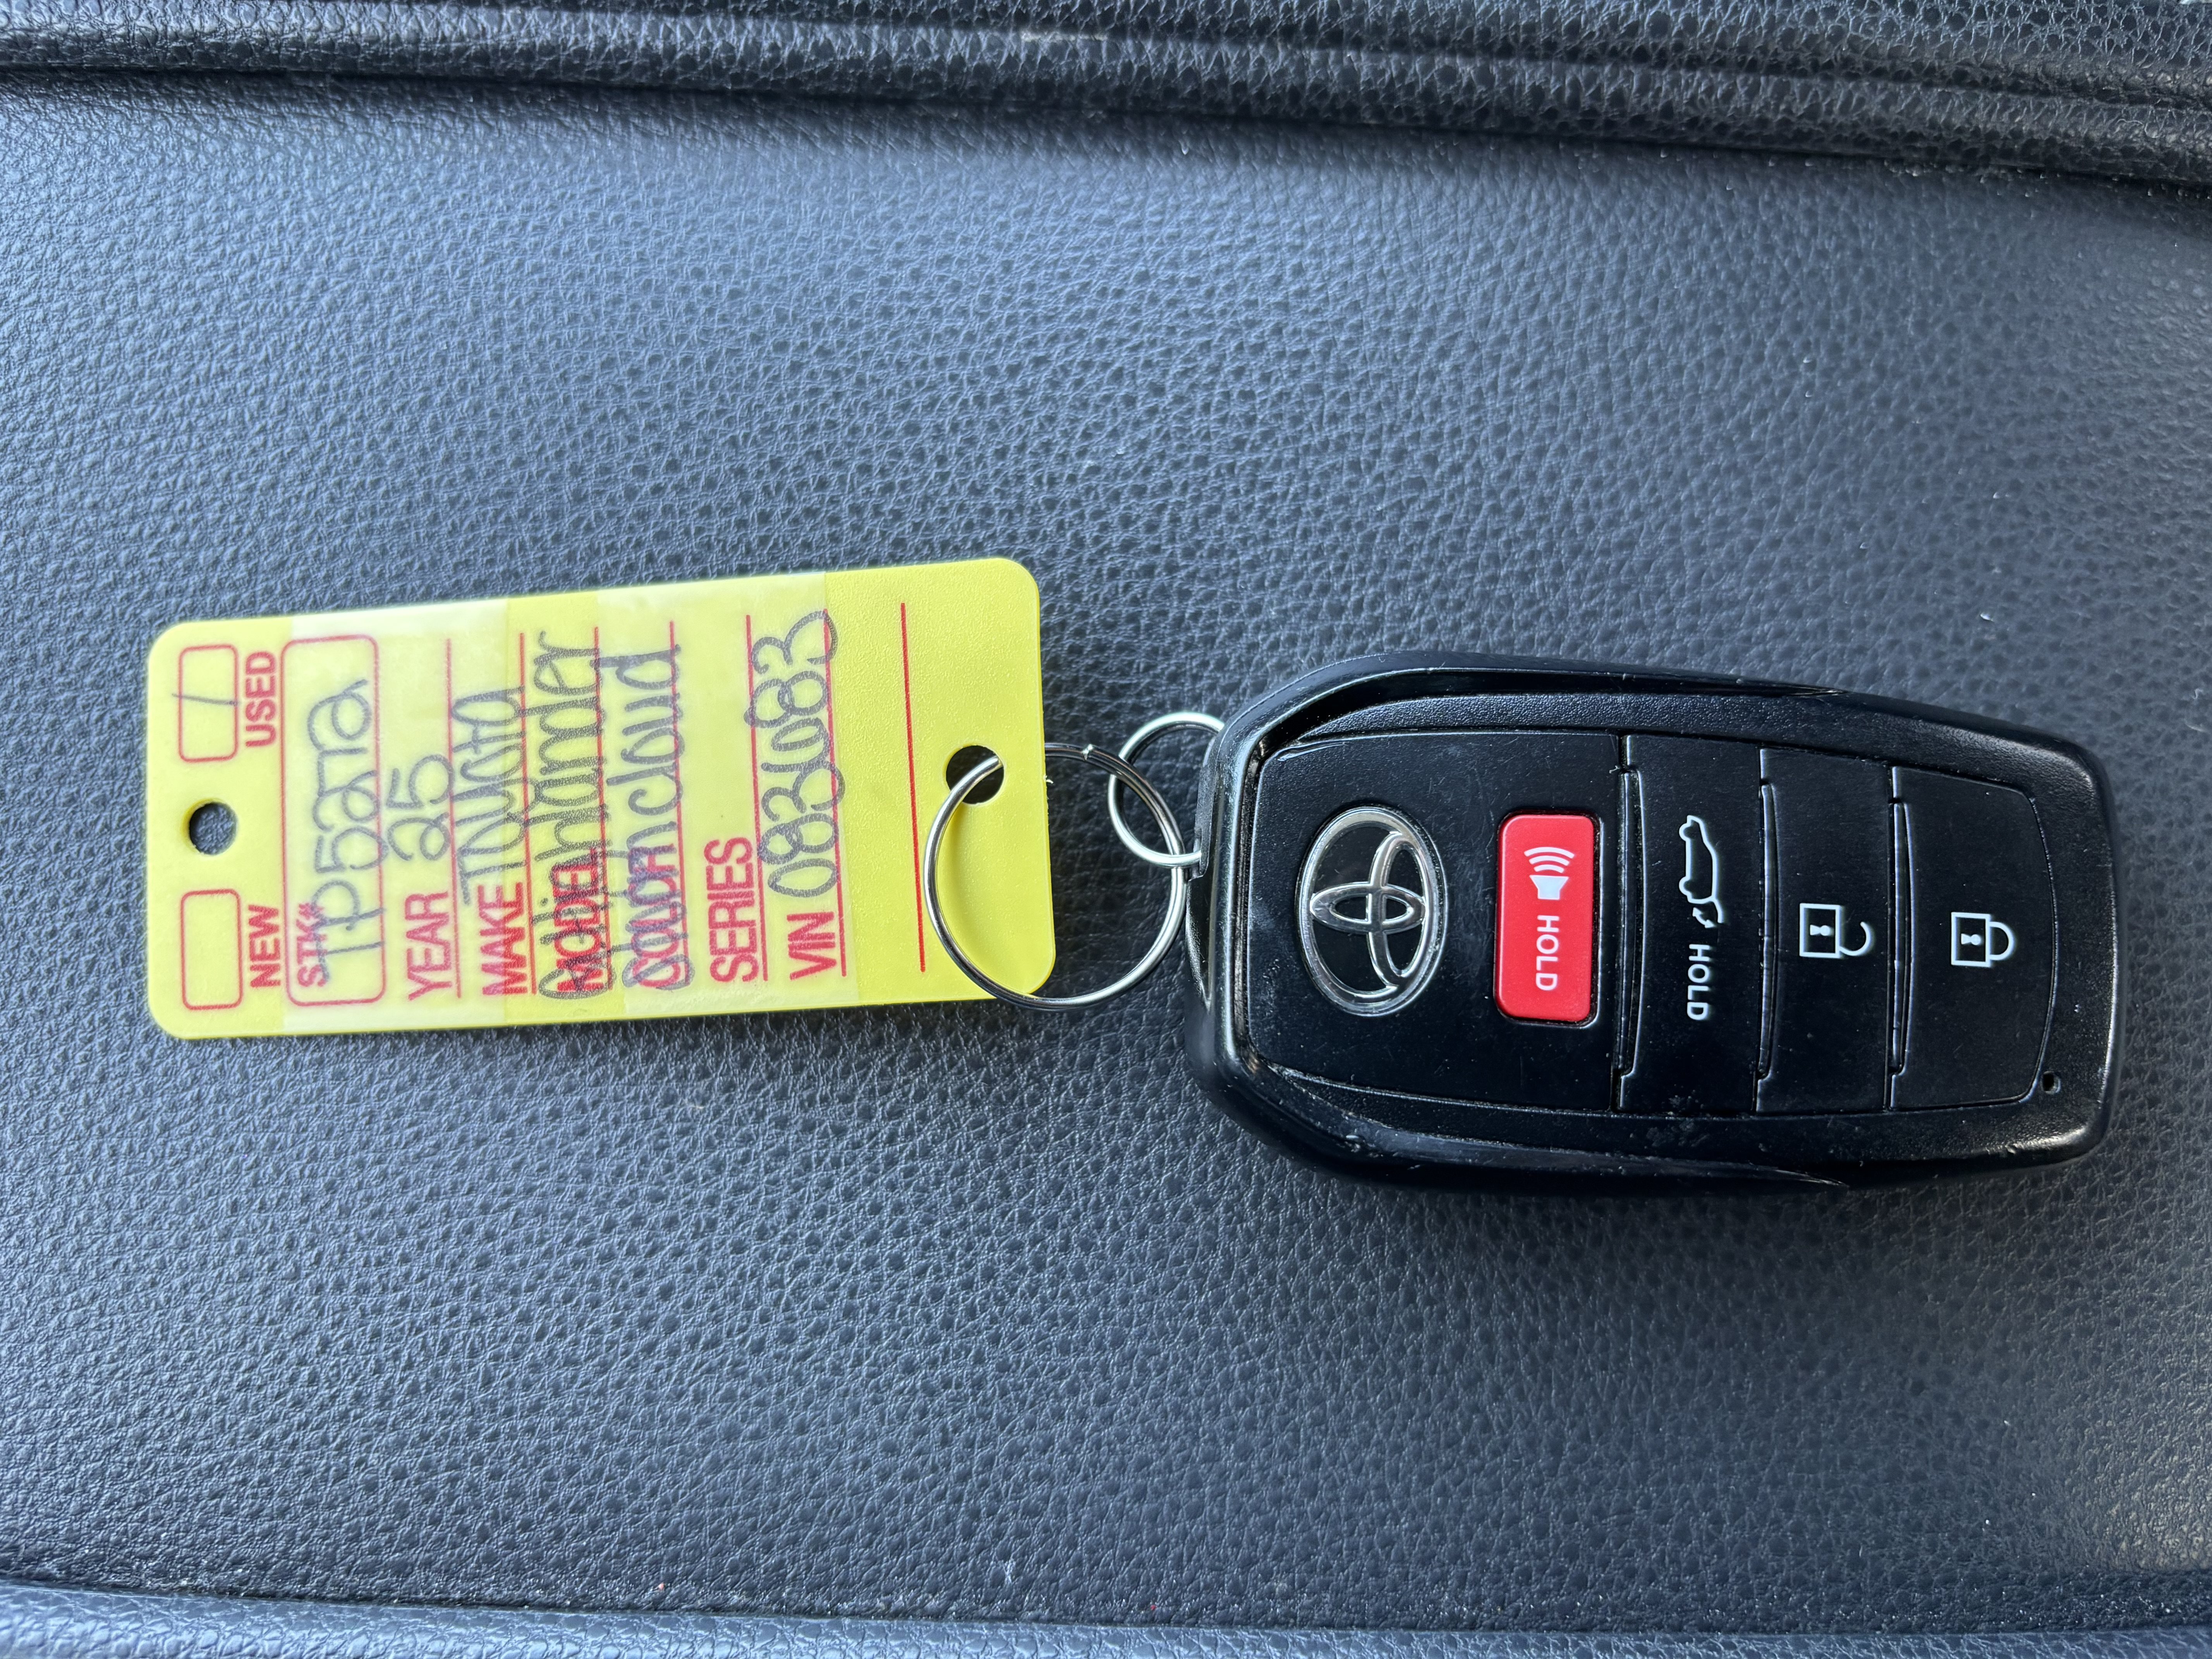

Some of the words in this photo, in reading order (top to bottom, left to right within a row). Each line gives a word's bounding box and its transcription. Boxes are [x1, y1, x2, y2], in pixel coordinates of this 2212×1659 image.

[245, 651, 276, 747] USED
[451, 685, 541, 905] Toyota
[743, 610, 845, 897] 083683
[386, 754, 453, 861] 25
[249, 905, 280, 988] NEW
[296, 903, 328, 987] STK#
[404, 892, 452, 999] YEAR
[478, 883, 527, 995] MAKE
[553, 848, 603, 991] MODEL
[628, 844, 680, 987] COLOR
[704, 838, 759, 983] SERIES
[787, 912, 837, 981] VIN
[1536, 915, 1559, 990] HOLD
[1687, 944, 1710, 1020] HOLD
